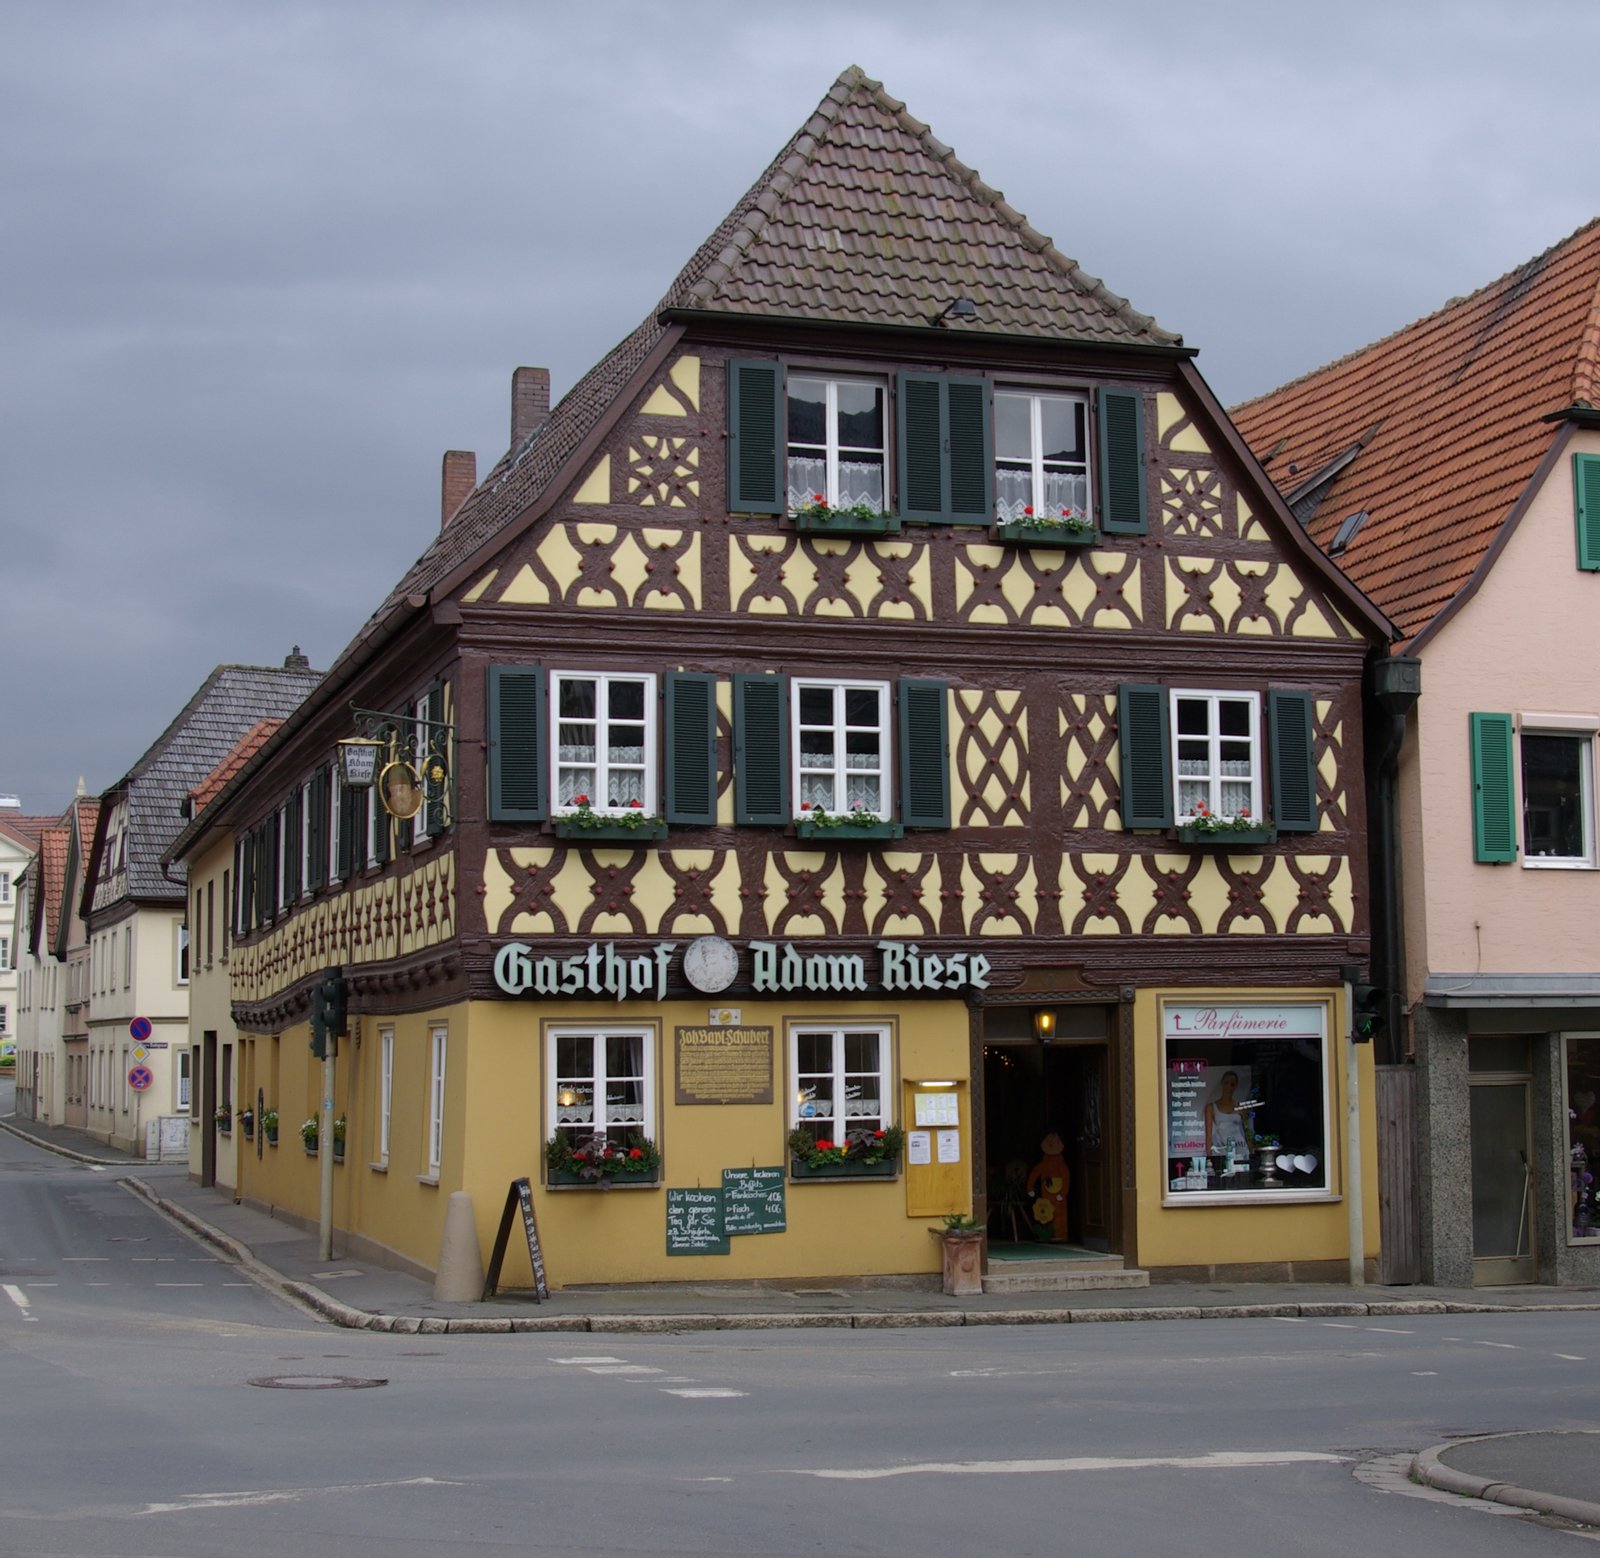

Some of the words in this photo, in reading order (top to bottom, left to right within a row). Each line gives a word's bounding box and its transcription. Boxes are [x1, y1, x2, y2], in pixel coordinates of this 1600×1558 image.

[494, 941, 678, 1002] Gasthof
[748, 940, 868, 993] Adam
[876, 940, 991, 992] Riese
[1193, 1008, 1288, 1037] Parfümerie
[669, 1191, 683, 1202] Wir
[685, 1191, 716, 1202] kochen
[668, 1216, 682, 1228] Tag
[701, 1214, 716, 1226] Sie
